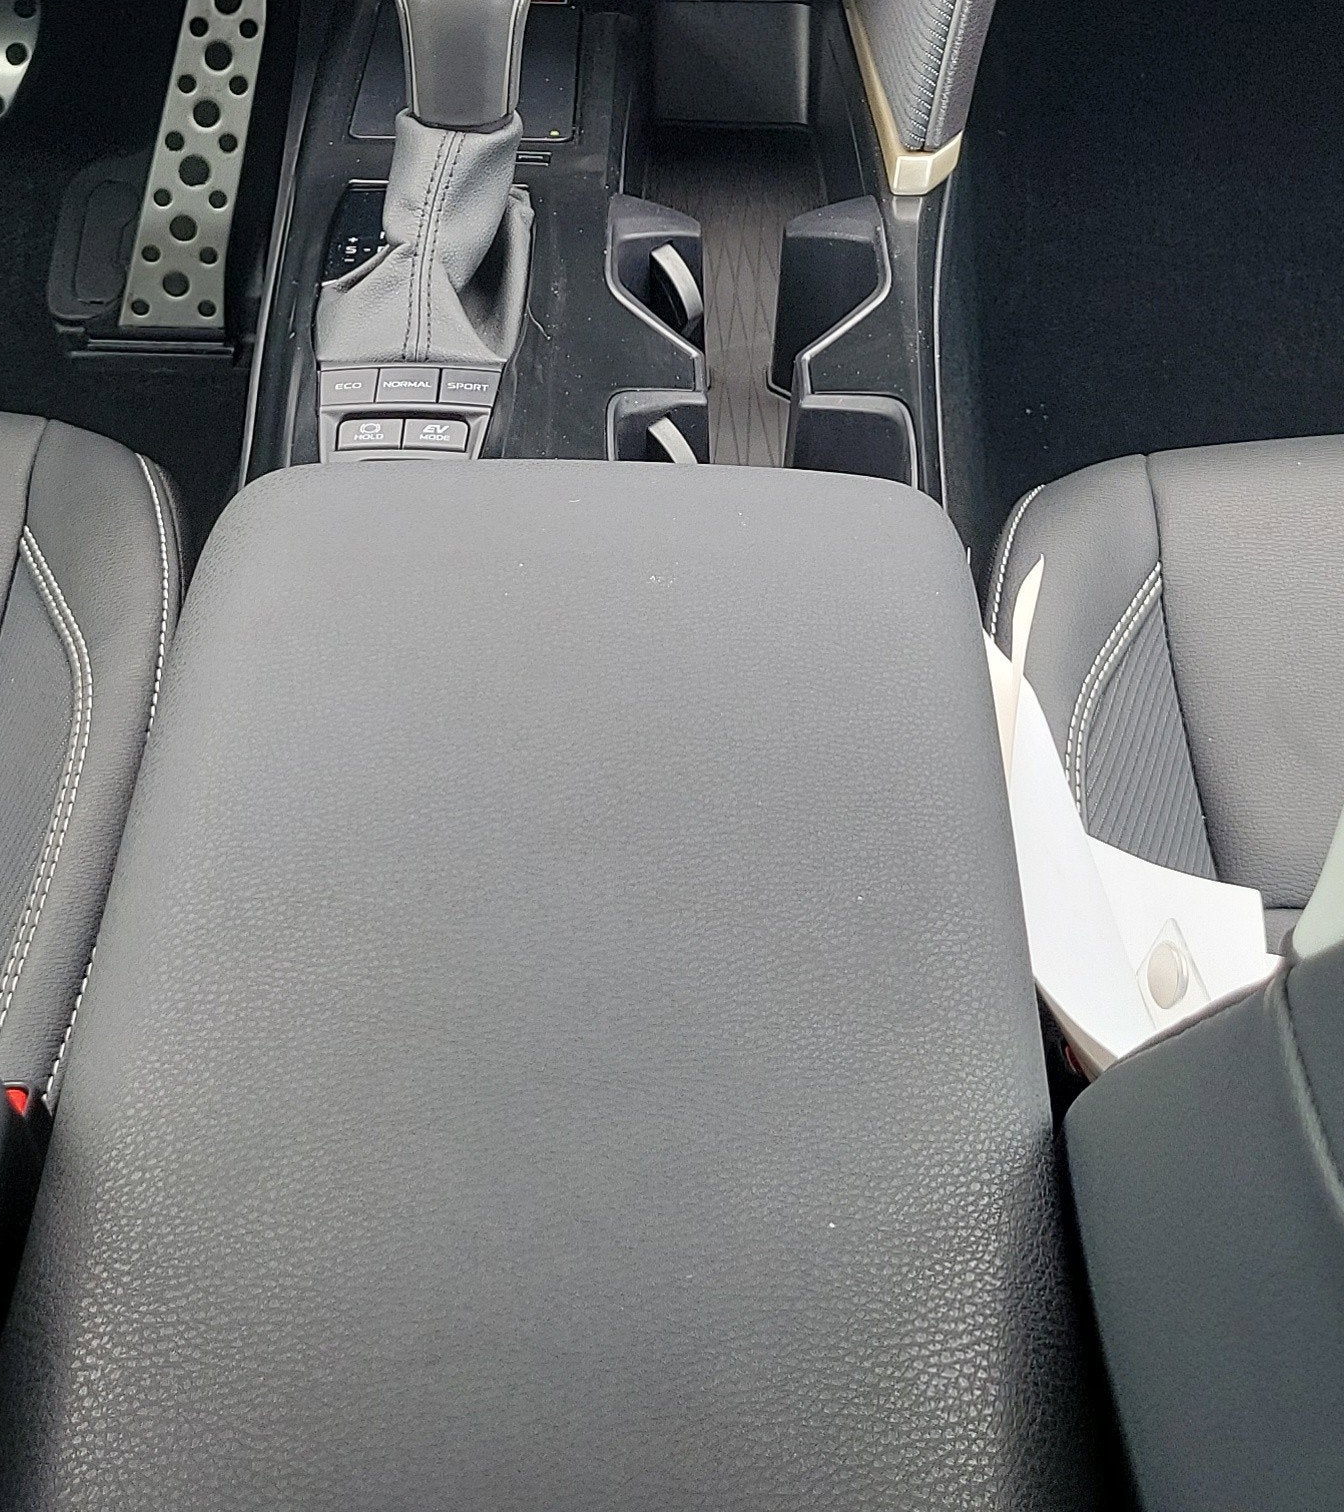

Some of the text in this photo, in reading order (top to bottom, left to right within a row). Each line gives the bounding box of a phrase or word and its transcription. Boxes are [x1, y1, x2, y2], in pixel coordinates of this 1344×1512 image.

[335, 382, 362, 390] ECO
[382, 380, 432, 389] NORMAL
[446, 382, 490, 392] SPORT
[422, 424, 450, 434] EV
[354, 433, 384, 441] HOLD
[419, 433, 451, 441] MODE
